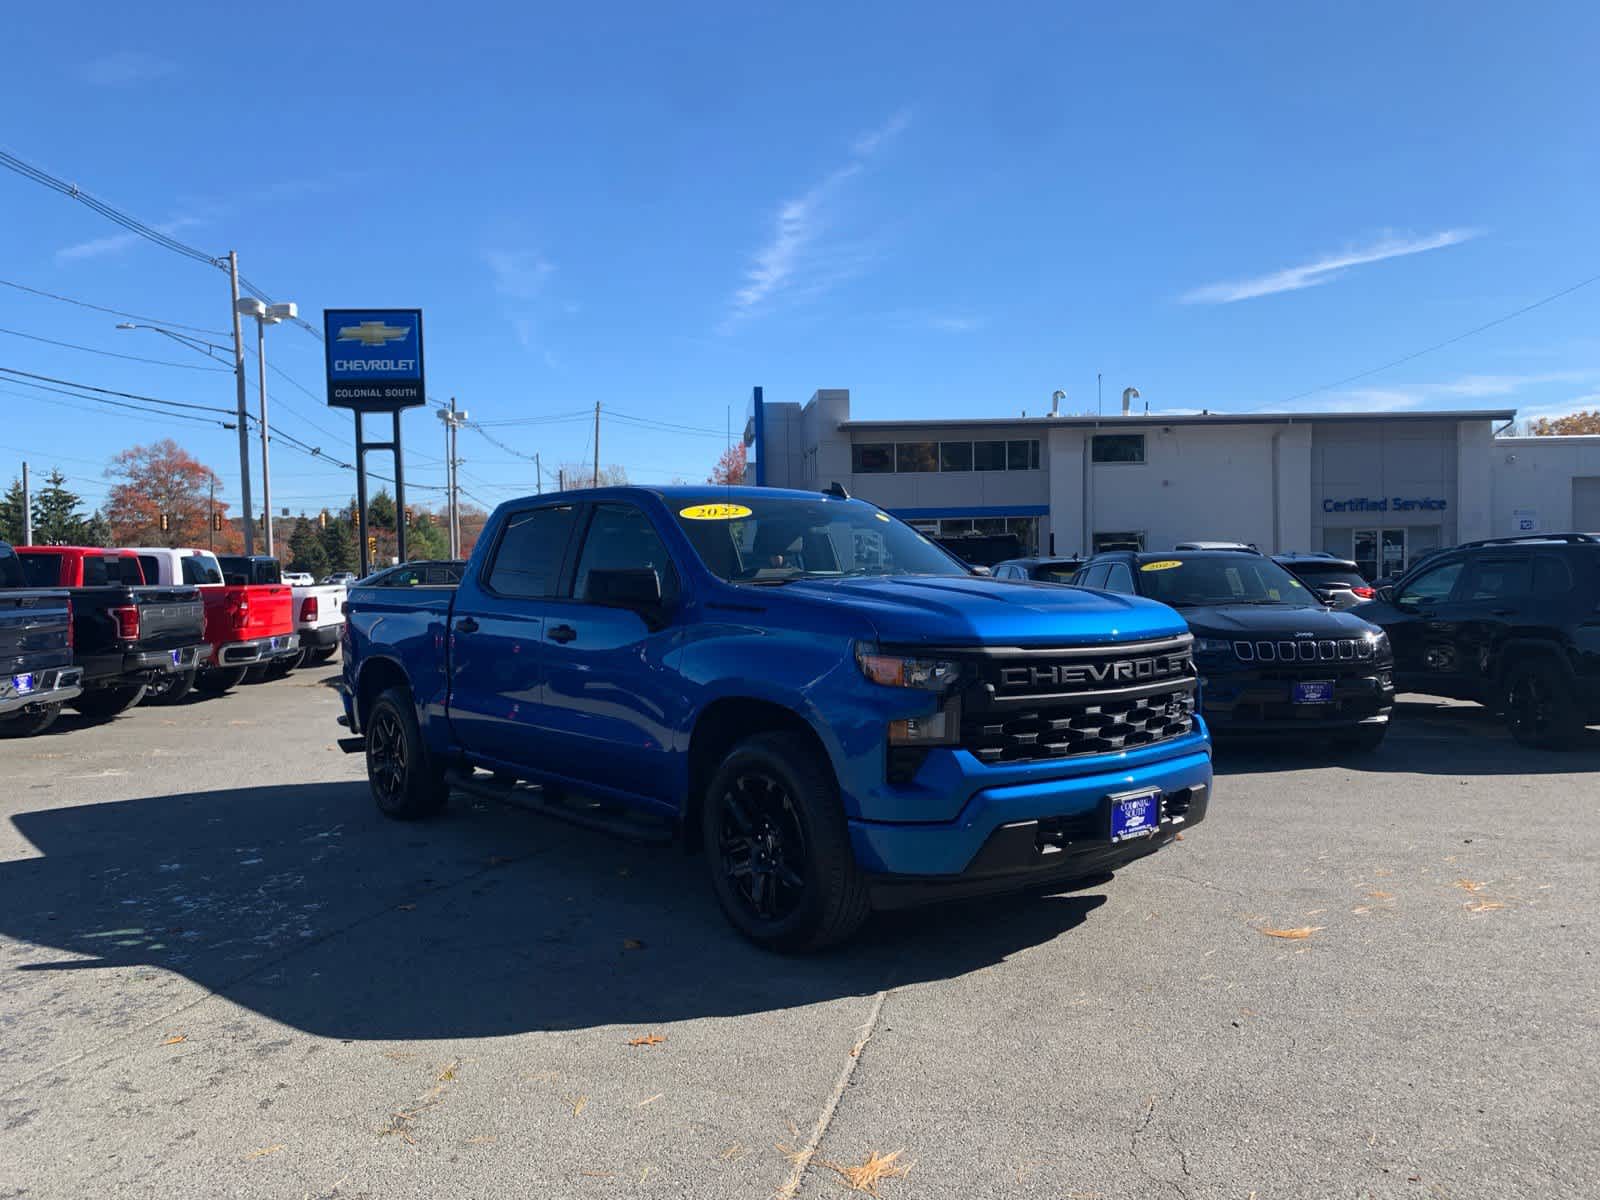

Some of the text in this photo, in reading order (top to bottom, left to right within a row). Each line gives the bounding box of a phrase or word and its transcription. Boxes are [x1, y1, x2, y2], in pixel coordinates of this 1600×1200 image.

[334, 359, 415, 371] CHEVROLET
[335, 388, 417, 398] COLONIAL SOUTH
[1322, 497, 1448, 513] Certified Service
